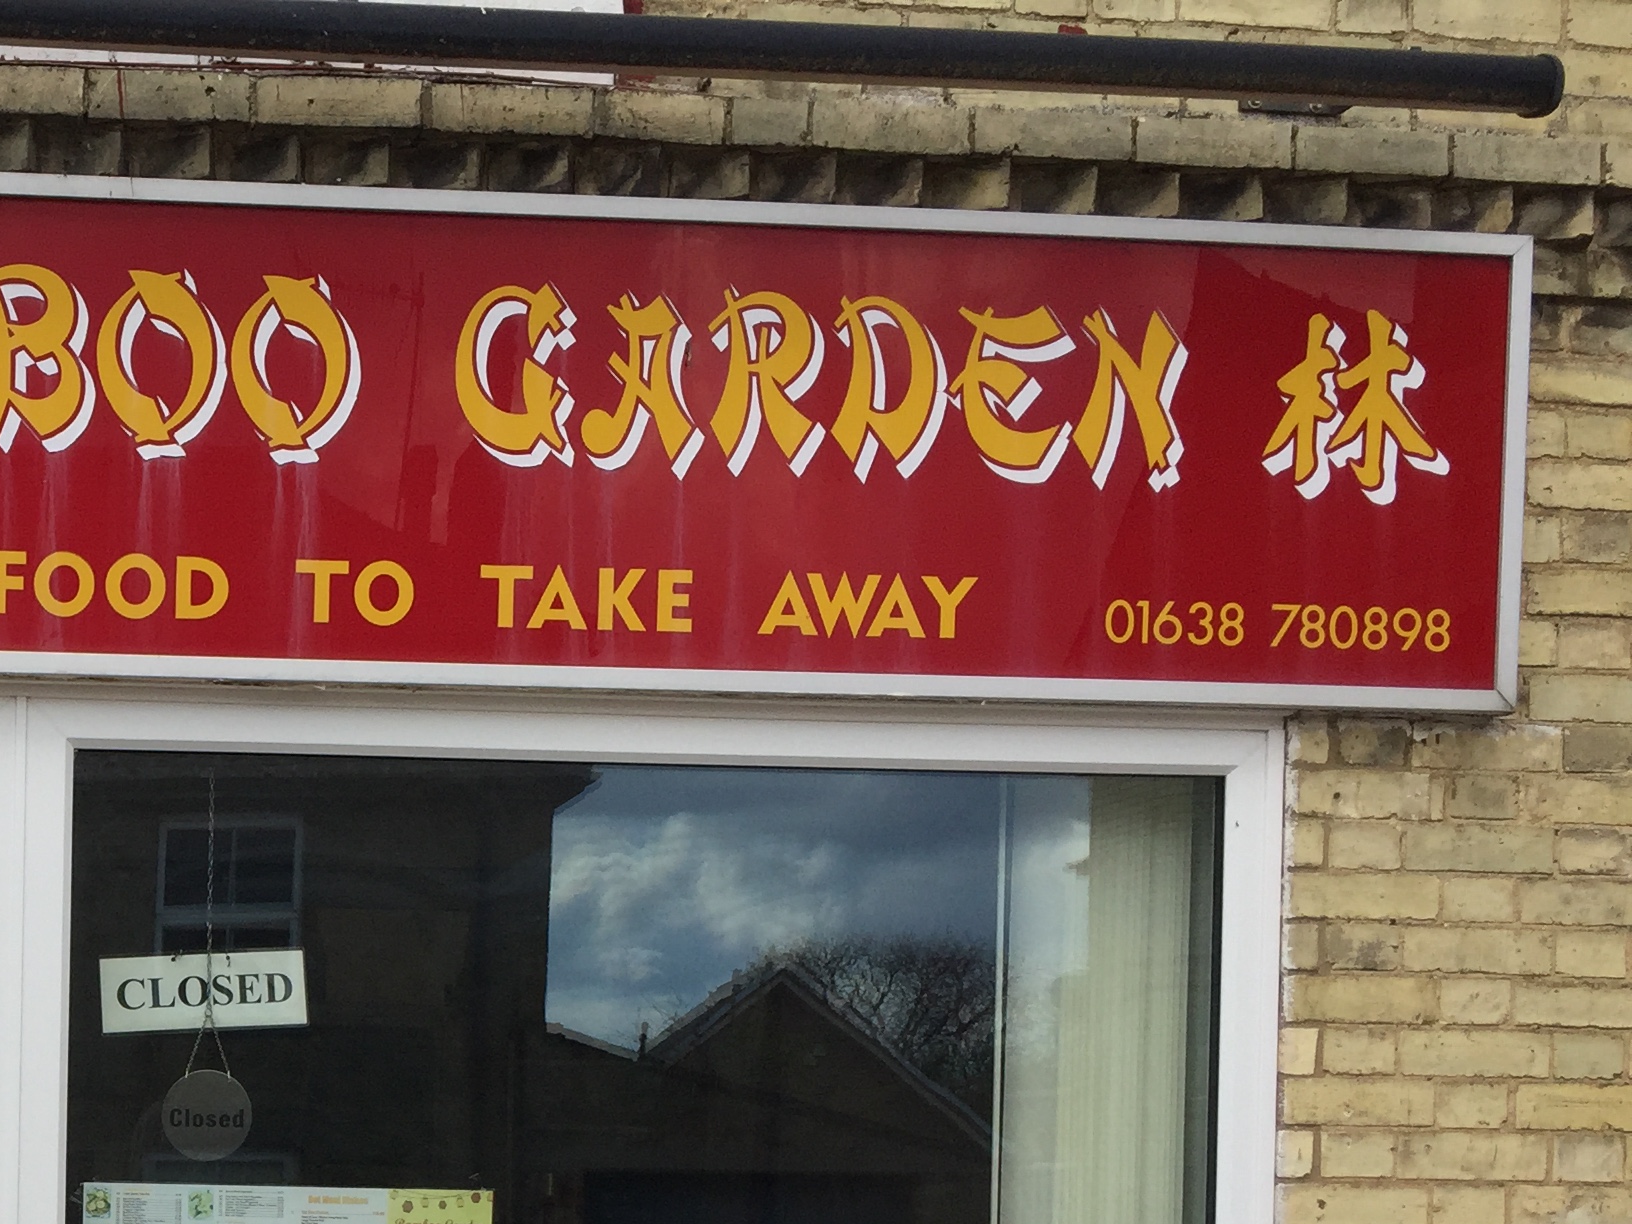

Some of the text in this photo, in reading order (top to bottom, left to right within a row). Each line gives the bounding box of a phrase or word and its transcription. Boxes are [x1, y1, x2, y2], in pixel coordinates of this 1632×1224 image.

[454, 288, 1189, 493] GARDEN
[1261, 308, 1450, 506] 林
[295, 559, 416, 626] TO
[479, 563, 694, 634] TAKE
[757, 569, 978, 640] AWAY
[1104, 599, 1452, 652] 01638 780898
[116, 972, 293, 1011] CLOSED
[169, 1108, 245, 1129] Closed
